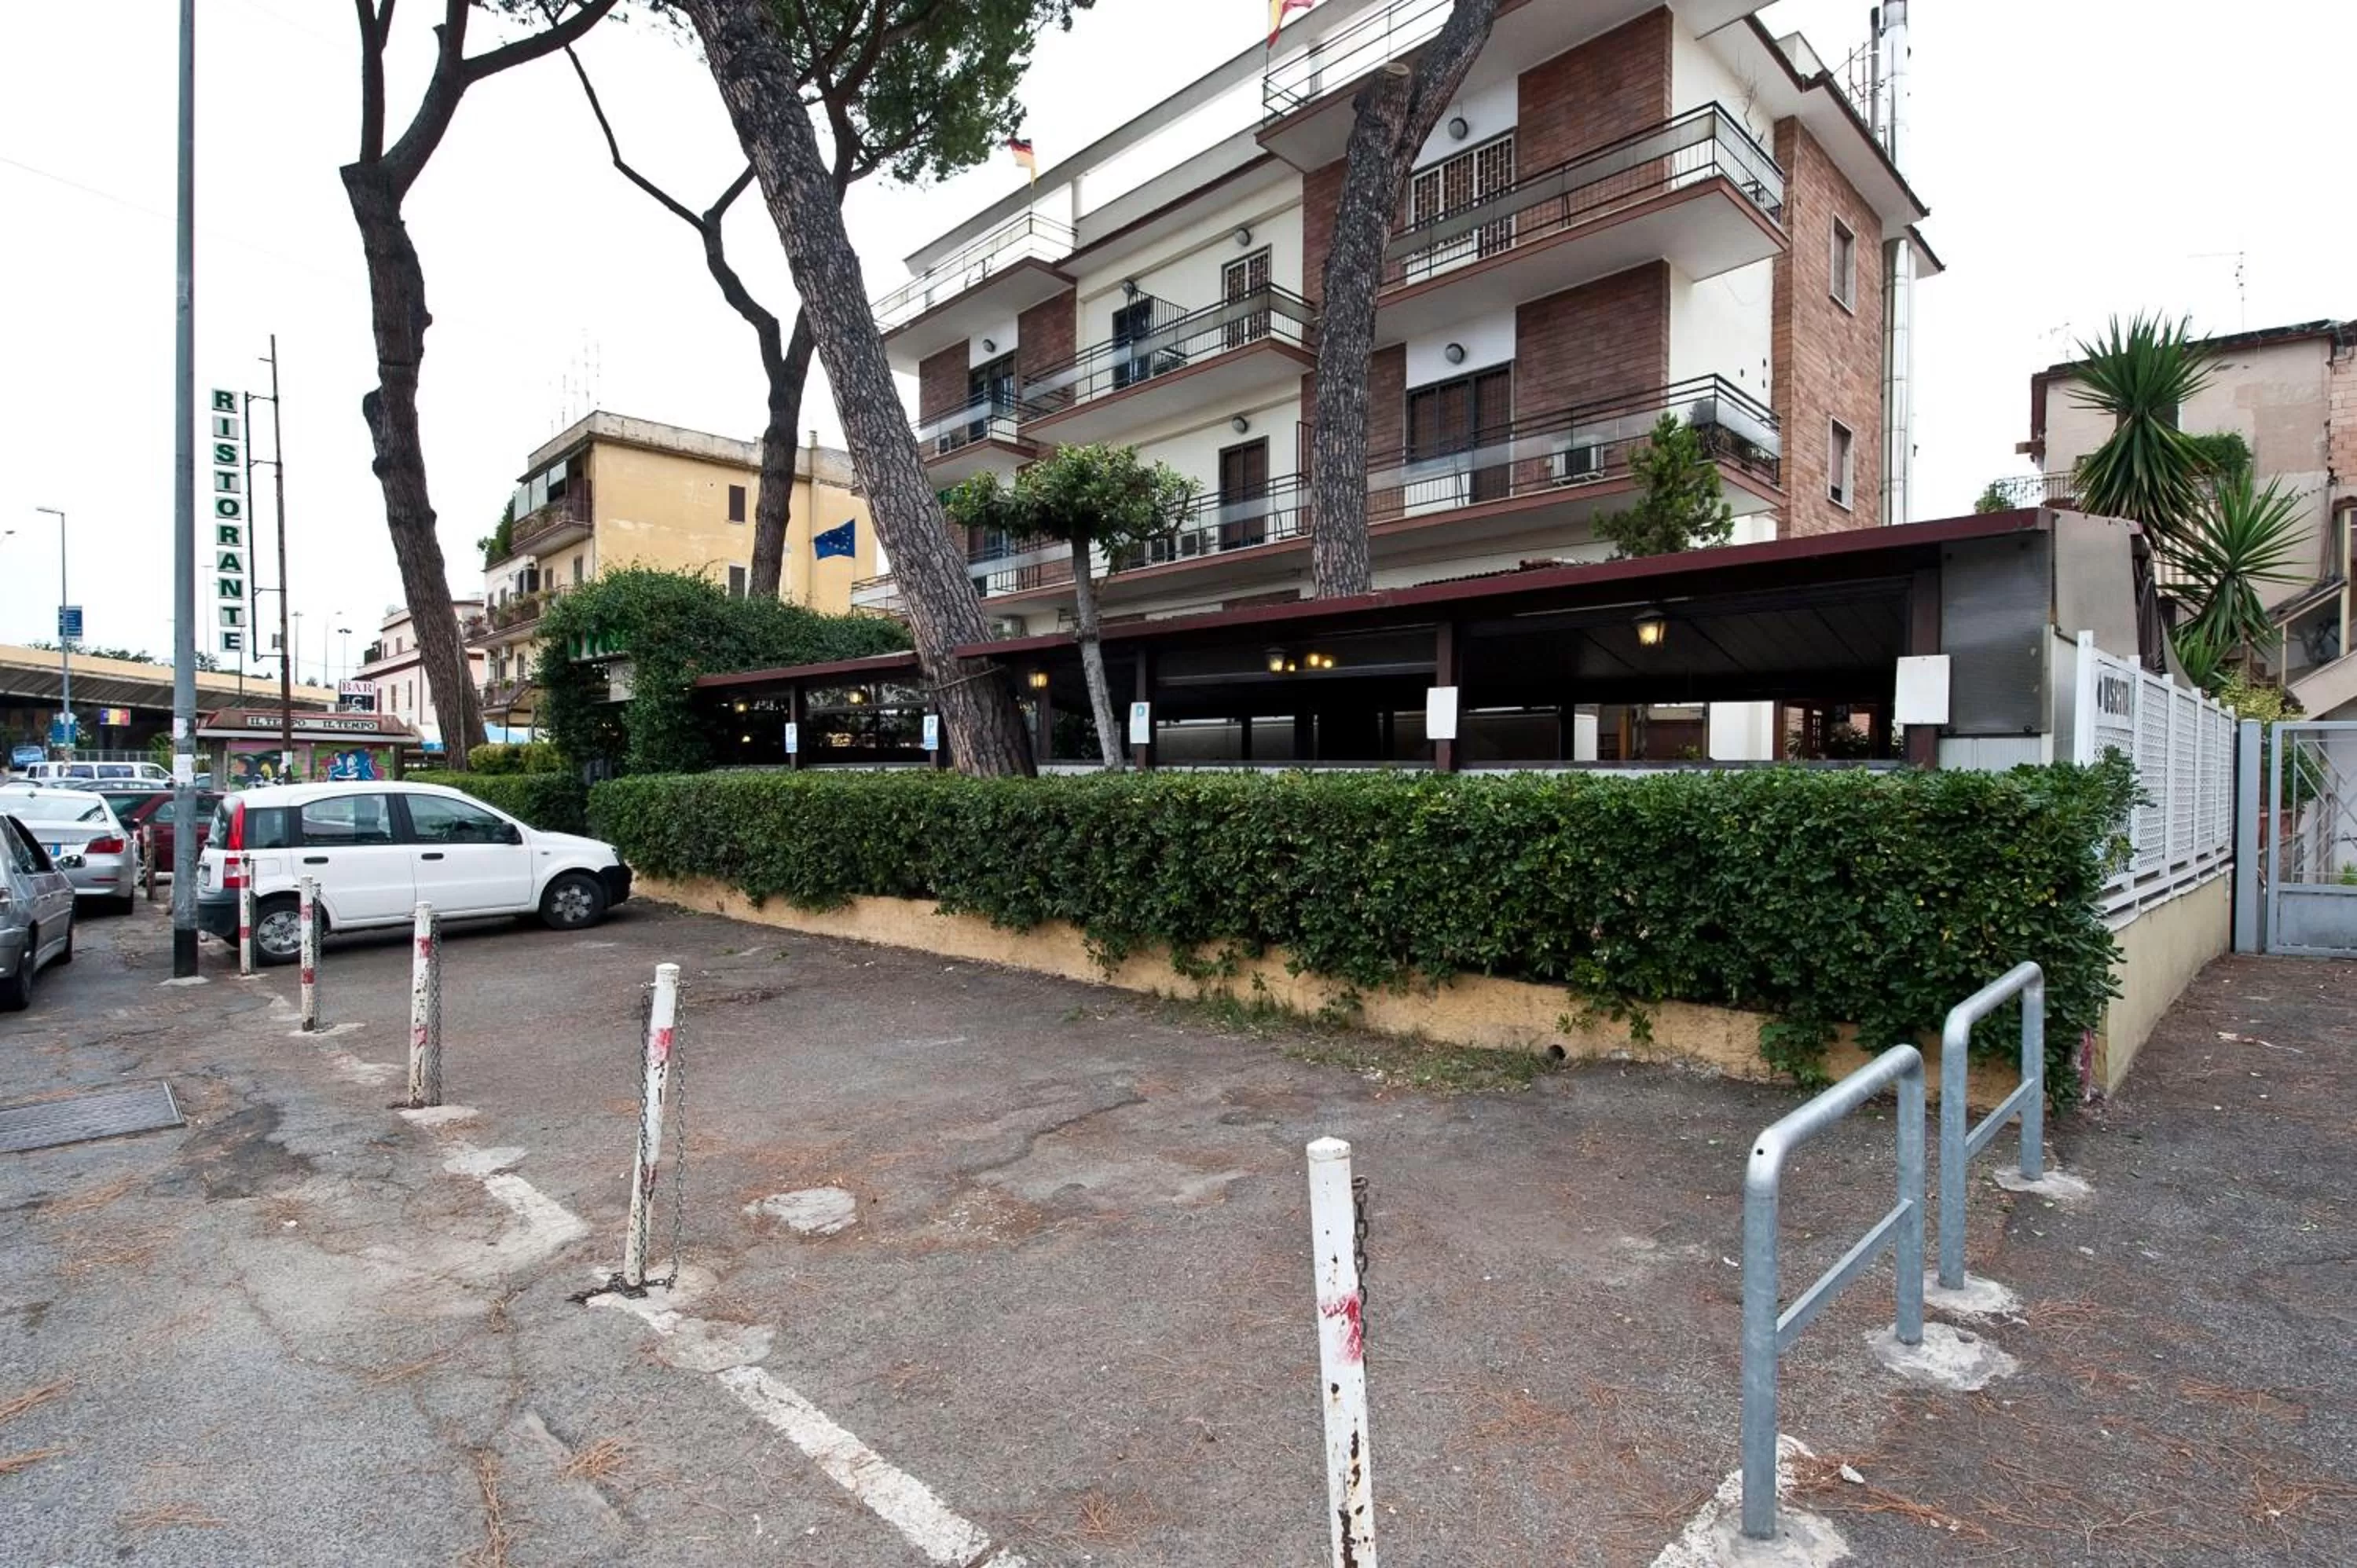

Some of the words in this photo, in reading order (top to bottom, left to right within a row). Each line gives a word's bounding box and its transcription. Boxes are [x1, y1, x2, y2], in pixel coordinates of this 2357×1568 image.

[214, 390, 242, 650] RISTORANTE
[342, 682, 372, 692] BAR
[266, 717, 306, 727] TEPO
[323, 720, 335, 728] IL
[337, 720, 375, 730] TEMPO
